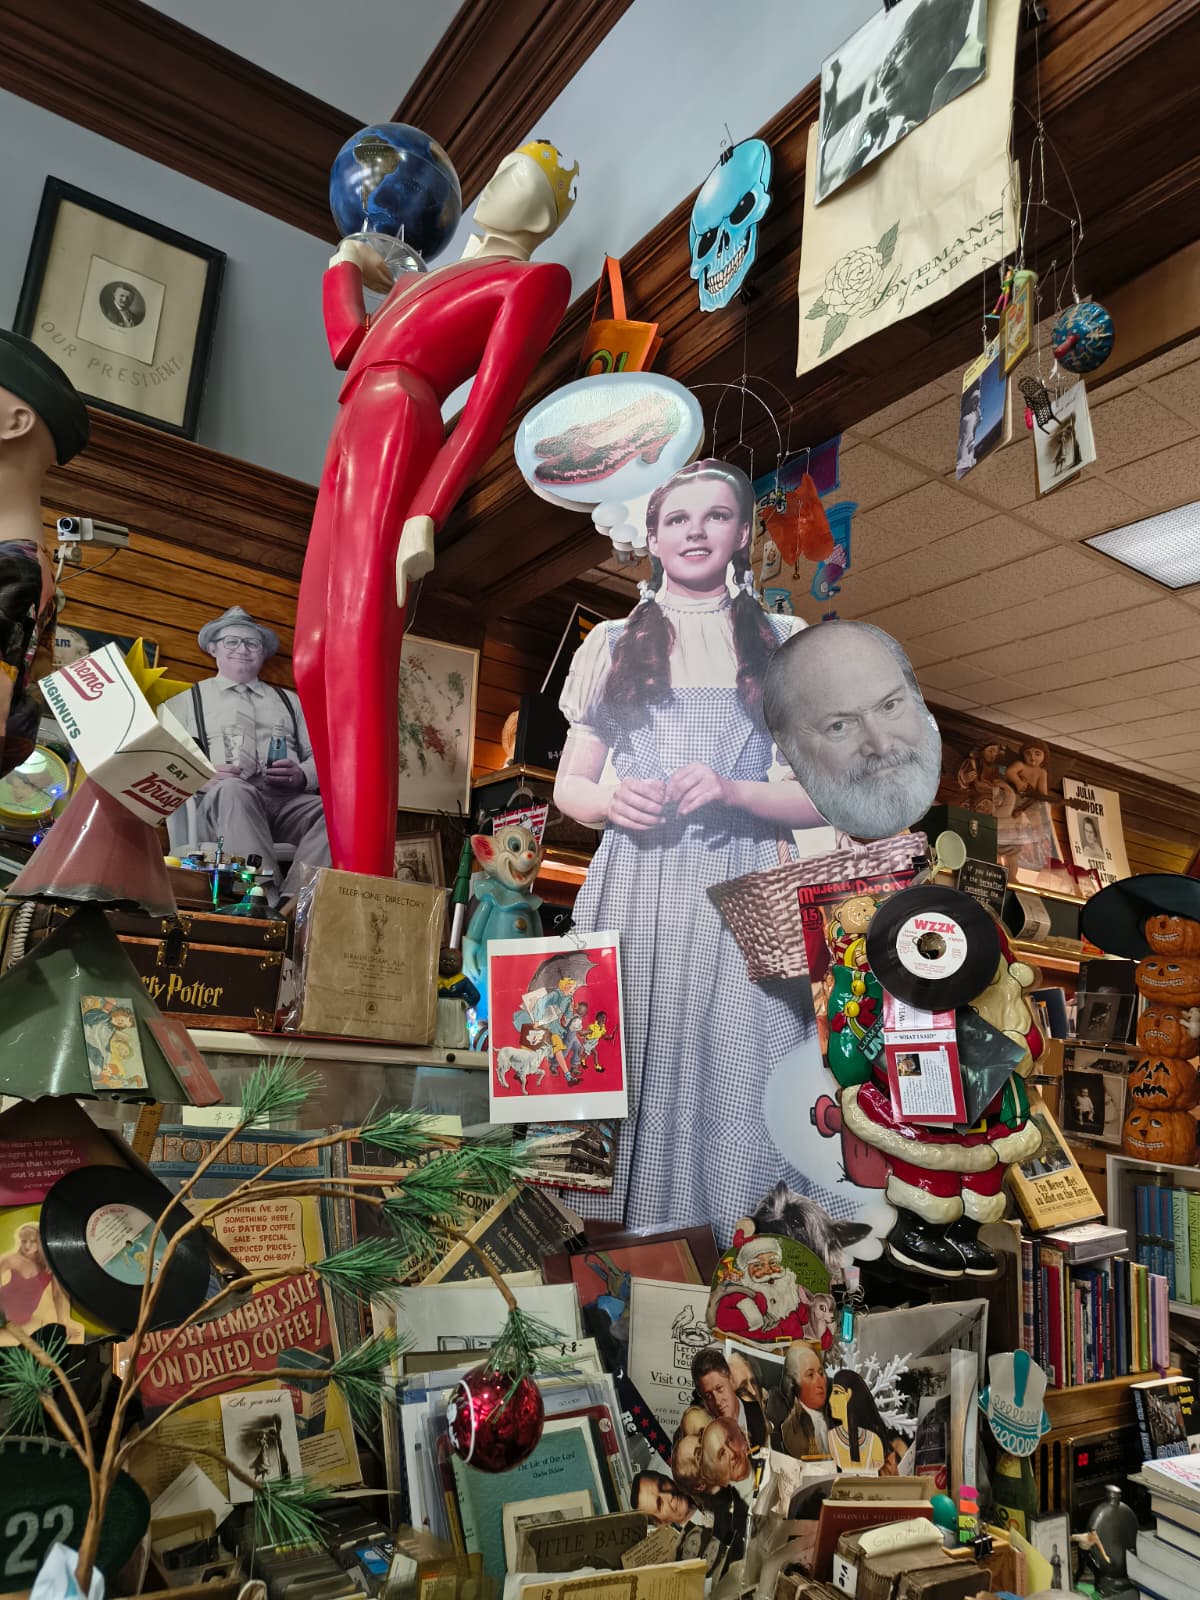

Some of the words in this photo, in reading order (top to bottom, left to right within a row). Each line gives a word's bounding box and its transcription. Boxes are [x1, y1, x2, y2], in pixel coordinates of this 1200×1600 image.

[911, 228, 1005, 296] ALABAMA
[41, 321, 77, 357] OUR
[87, 356, 181, 389] PRESIDENT
[43, 676, 81, 739] UGHNUTS
[166, 763, 189, 781] EAT
[1075, 786, 1096, 801] JULIA
[338, 886, 380, 902] TELEPHONE
[385, 895, 425, 909] DIRECTORY
[914, 918, 956, 934] WZZK
[140, 975, 166, 1000] rry
[166, 973, 224, 1009] Potter
[260, 1204, 271, 1212] I'VE
[224, 1215, 267, 1224] SOMETHING
[223, 1226, 235, 1234] BIG
[238, 1224, 267, 1233] DATED
[269, 1223, 296, 1231] COFFEE
[259, 1234, 288, 1242] SPECIAL
[229, 1245, 263, 1253] REDUCED
[237, 1255, 261, 1263] H-BOY,
[139, 1332, 171, 1355] BIG
[176, 1294, 280, 1349] SEPTEMBER
[278, 1273, 317, 1315] SALE
[150, 1355, 184, 1389] ON
[184, 1340, 251, 1382] DATED
[253, 1304, 322, 1360] COFFEE!
[676, 1359, 692, 1367] YOU
[650, 1370, 674, 1385] Visit
[678, 1391, 693, 1403] Co
[5, 1504, 74, 1576] 22
[536, 1534, 585, 1559] ITTLE
